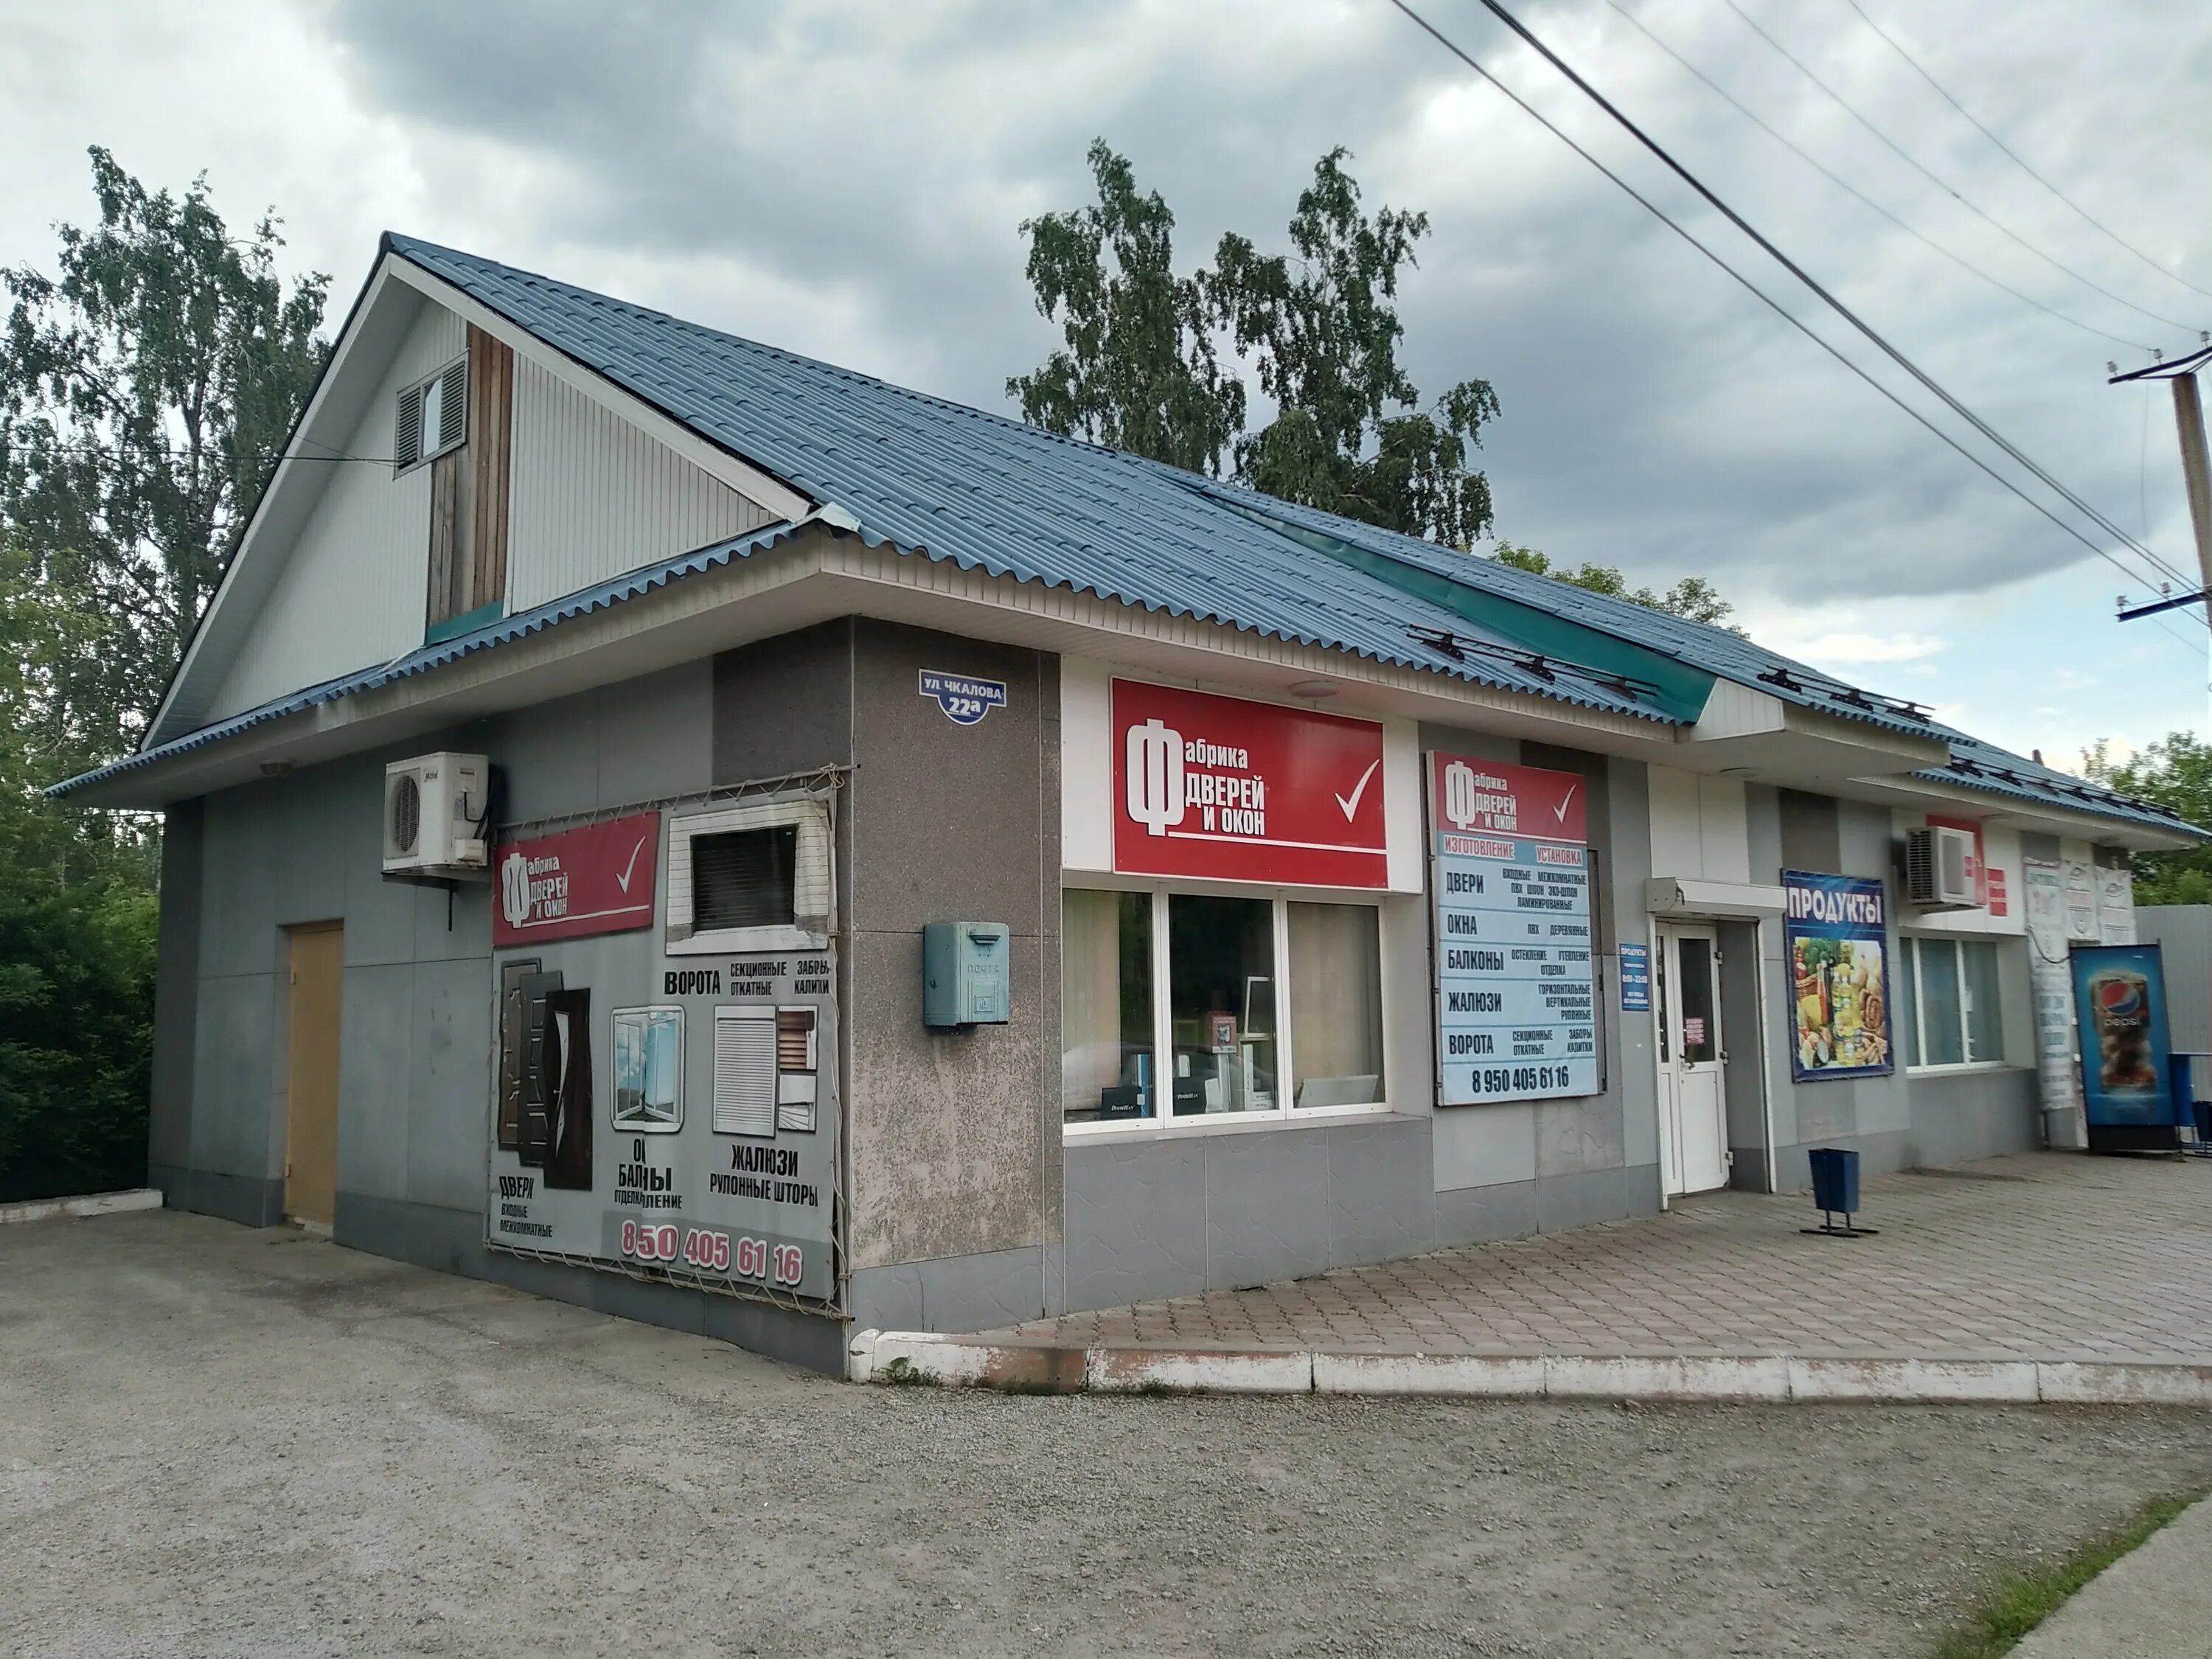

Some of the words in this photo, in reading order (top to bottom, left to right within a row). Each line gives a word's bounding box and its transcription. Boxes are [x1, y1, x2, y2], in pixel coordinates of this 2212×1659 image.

[925, 678, 942, 690] УЛ.
[945, 680, 1002, 700] ЧКАЛОВА
[1127, 718, 1248, 837] Фабрика
[1186, 772, 1265, 810] ДВЕРЕЙ
[1475, 793, 1516, 815] ДВЕРЕЙ
[1203, 806, 1215, 831] И
[1222, 808, 1265, 835] ОКОН
[1484, 813, 1492, 828] И
[1494, 813, 1517, 831] ОКОН
[1444, 835, 1514, 859] ИЗГОТОВЛЕНИЕ
[1536, 846, 1582, 865] УСТАНОВКА
[530, 872, 568, 905] ДВЕРЕЙ
[1446, 872, 1484, 894] ДВЕРИ
[1503, 868, 1531, 881] ВХОДНЫЕ
[1538, 871, 1587, 886] МЕЖКОМНАТНЫЕ
[1512, 883, 1523, 894] ПВХ
[1527, 884, 1544, 895] ШПОН
[544, 897, 568, 918] ОКОН
[1517, 897, 1572, 911] ЛАМИНИРОВАННЫЕ
[1788, 887, 1882, 924] ПРОДУКТЫ
[1447, 914, 1478, 935] ОКНА
[1528, 923, 1540, 934] ПВХ
[1550, 924, 1589, 936] ДЕРЕВЯННЫЕ
[1448, 949, 1504, 970] БАЛКОНЫ
[1512, 949, 1547, 961] ОСТЕКЛЕНИЕ
[1558, 950, 1590, 961] УТЕПЛЕНИЕ
[1540, 964, 1566, 976] ОТДЕЛКА
[664, 970, 720, 995] ВОРОТА
[730, 961, 787, 979] СЕКЦИОННЫЕ
[731, 981, 772, 996] ОТКАТНЫЕ
[1448, 992, 1501, 1012] ЖАЛЮЗИ
[1538, 984, 1590, 995] ГОРИЗОНТАЛЬНЫЕ
[1546, 997, 1591, 1008] ВЕРТИКАЛЬНЫЕ
[1561, 1009, 1591, 1020] РУЛОННЫЕ
[1449, 1034, 1494, 1054] ВОРОТА
[1512, 1030, 1553, 1043] СЕКЦИОННЫЕ
[1569, 1029, 1593, 1040] ЗАБОРЫ
[1514, 1044, 1545, 1056] ОТКАТНЫЕ
[1567, 1042, 1593, 1053] КАЛИТКИ
[1472, 1070, 1481, 1093] 8
[1484, 1069, 1510, 1093] 950
[1513, 1068, 1537, 1091] 405
[731, 1144, 798, 1178] ЖАЛЮЗИ
[499, 1176, 535, 1200] ДВЕРИ
[710, 1173, 771, 1200] РУЛОННЫЕ
[774, 1181, 818, 1208] ШТОРЫ
[684, 1228, 730, 1270] 405
[737, 1237, 767, 1279] 61
[774, 1244, 803, 1286] 16
